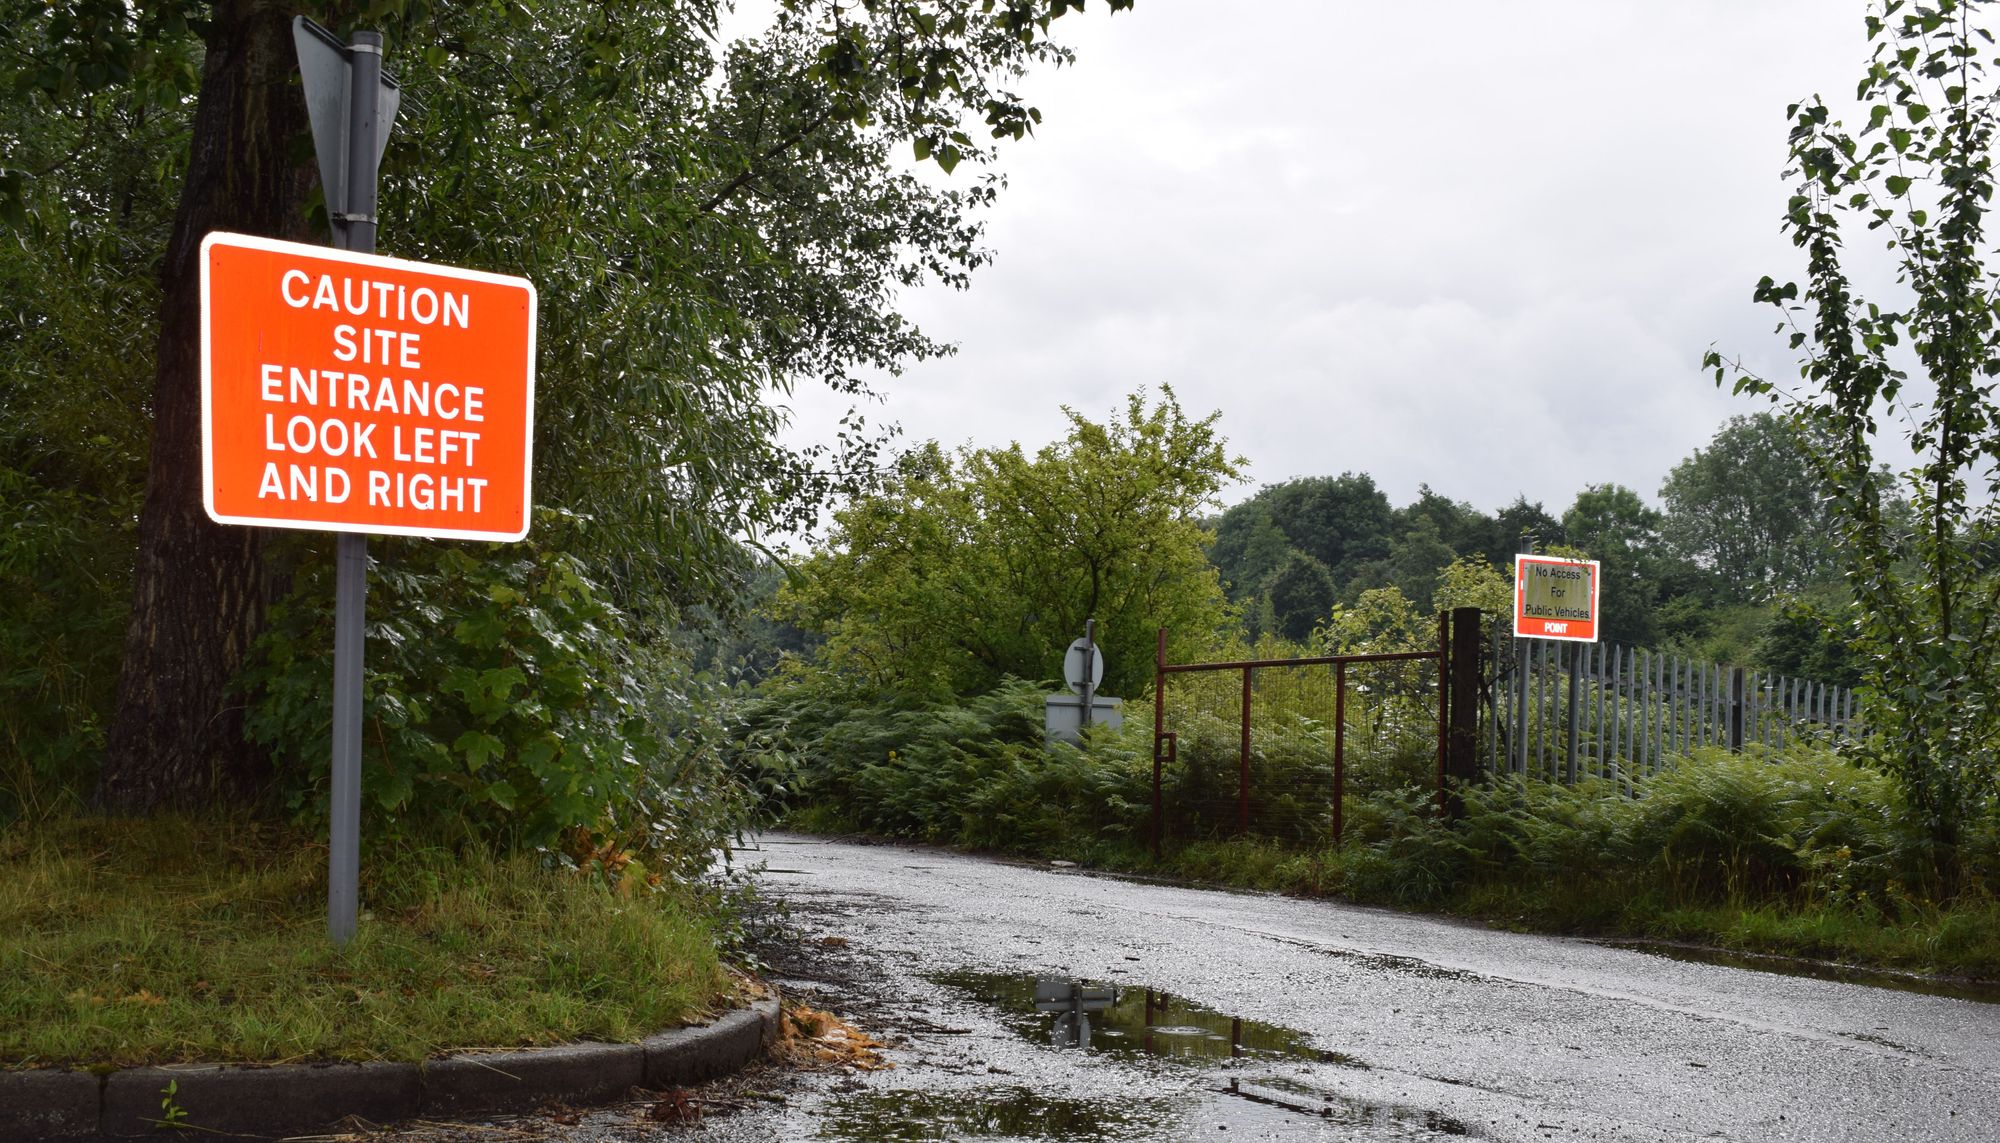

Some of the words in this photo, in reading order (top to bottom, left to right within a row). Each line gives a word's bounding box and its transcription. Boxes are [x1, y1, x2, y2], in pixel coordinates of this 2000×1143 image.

[281, 269, 469, 328] CAUTION
[333, 324, 421, 369] SITE
[261, 363, 485, 422] ENTRANCE
[265, 413, 377, 459] LOOK
[393, 425, 480, 466] LEFT
[257, 462, 351, 504] AND
[369, 470, 488, 513] RIGHT
[1536, 566, 1548, 577] No
[1550, 567, 1581, 580] Access
[1551, 586, 1565, 598] For
[1525, 604, 1552, 616] Public
[1554, 606, 1590, 619] Vehicles
[1544, 622, 1568, 633] POINT
